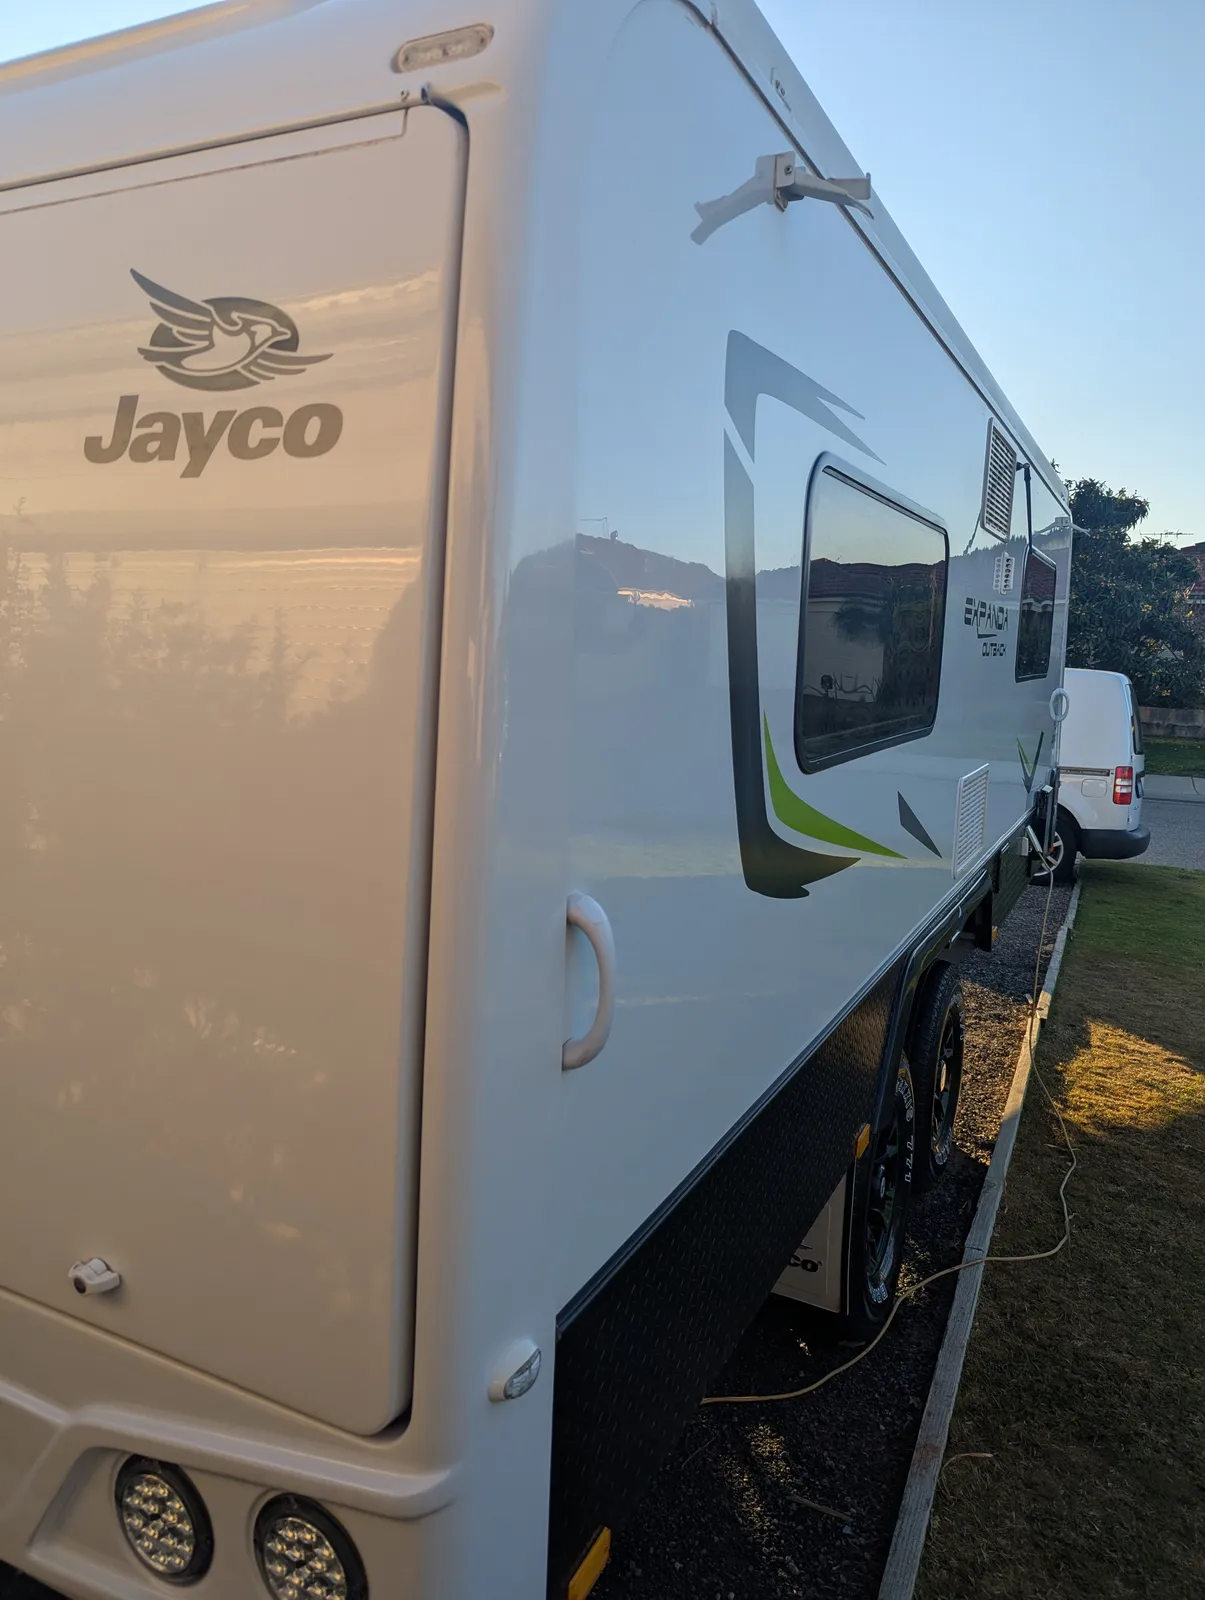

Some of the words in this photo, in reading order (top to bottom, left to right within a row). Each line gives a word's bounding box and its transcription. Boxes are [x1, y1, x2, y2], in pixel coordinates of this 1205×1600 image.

[84, 395, 343, 478] Jayco
[964, 597, 1008, 631] EXPANDA
[982, 642, 1006, 656] OUTBACK
